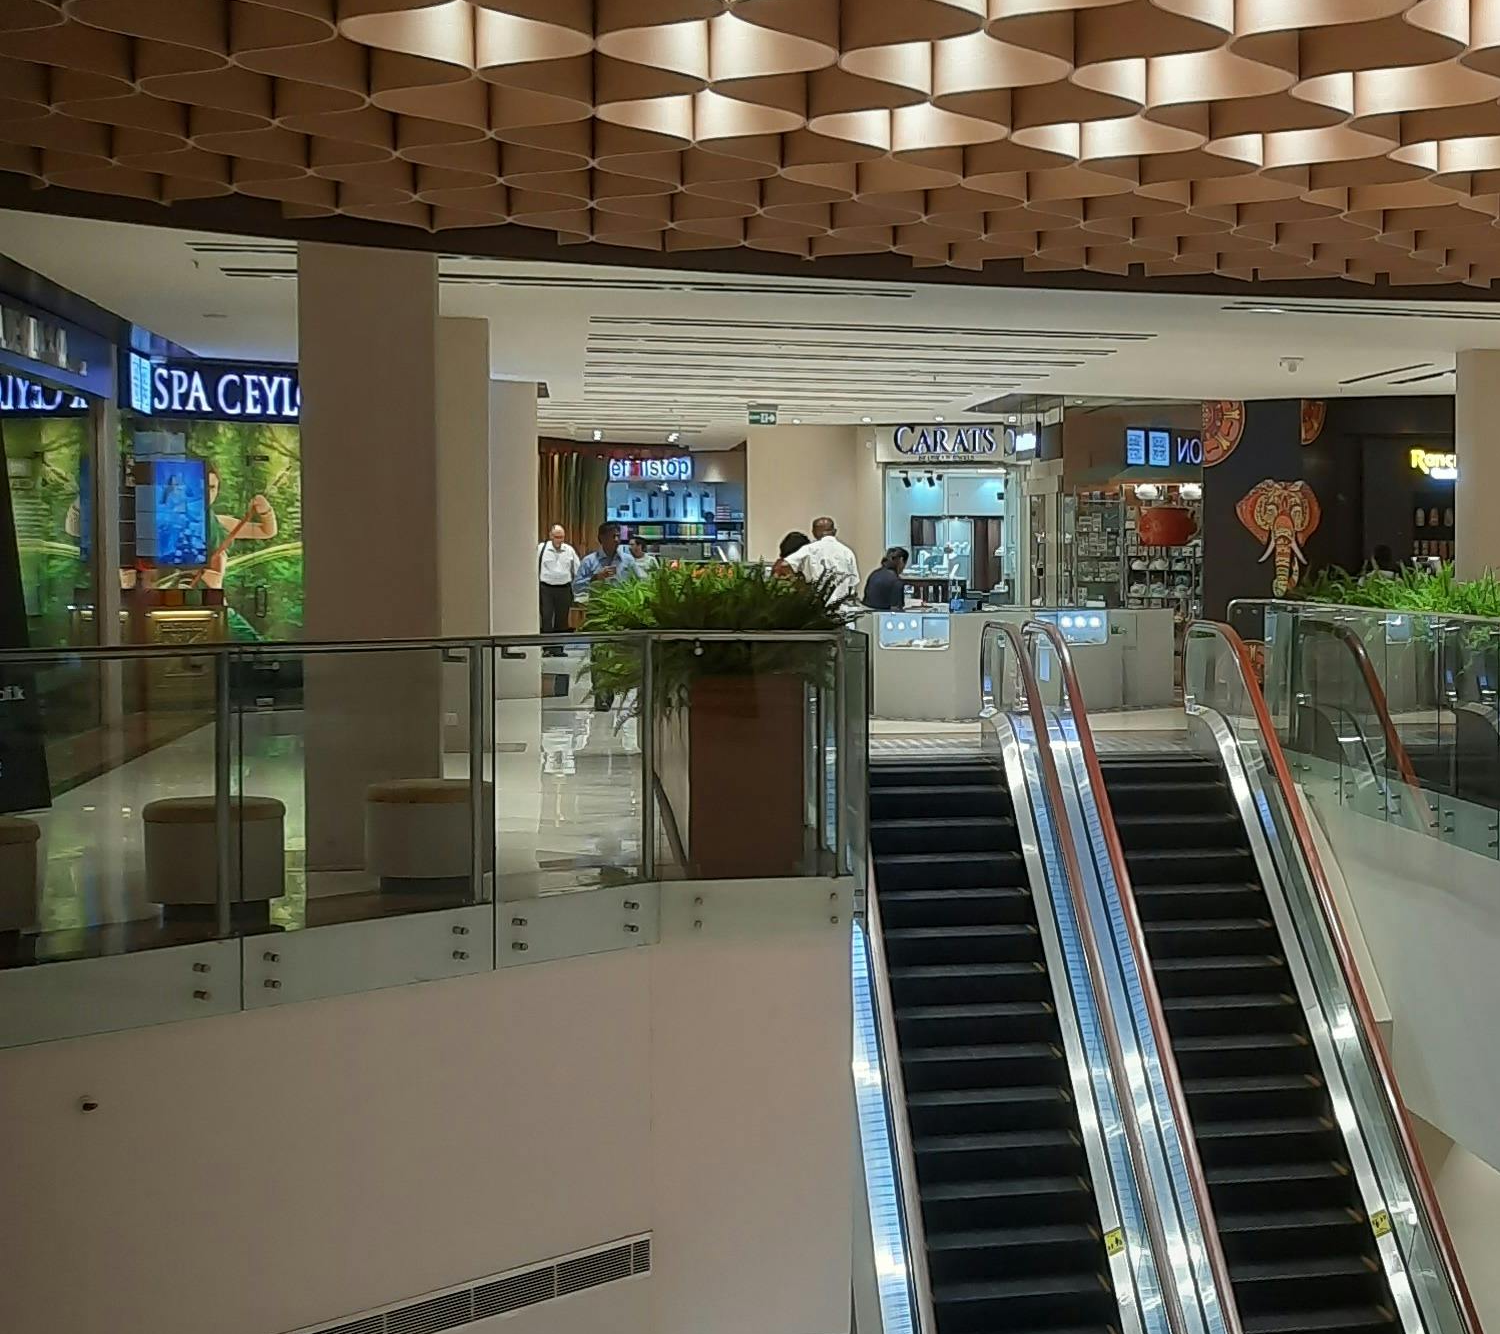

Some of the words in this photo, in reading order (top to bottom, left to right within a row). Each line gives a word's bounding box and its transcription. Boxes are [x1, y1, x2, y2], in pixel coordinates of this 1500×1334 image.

[154, 368, 213, 412] SPA
[217, 374, 300, 417] CEYL
[894, 424, 997, 455] CARATS
